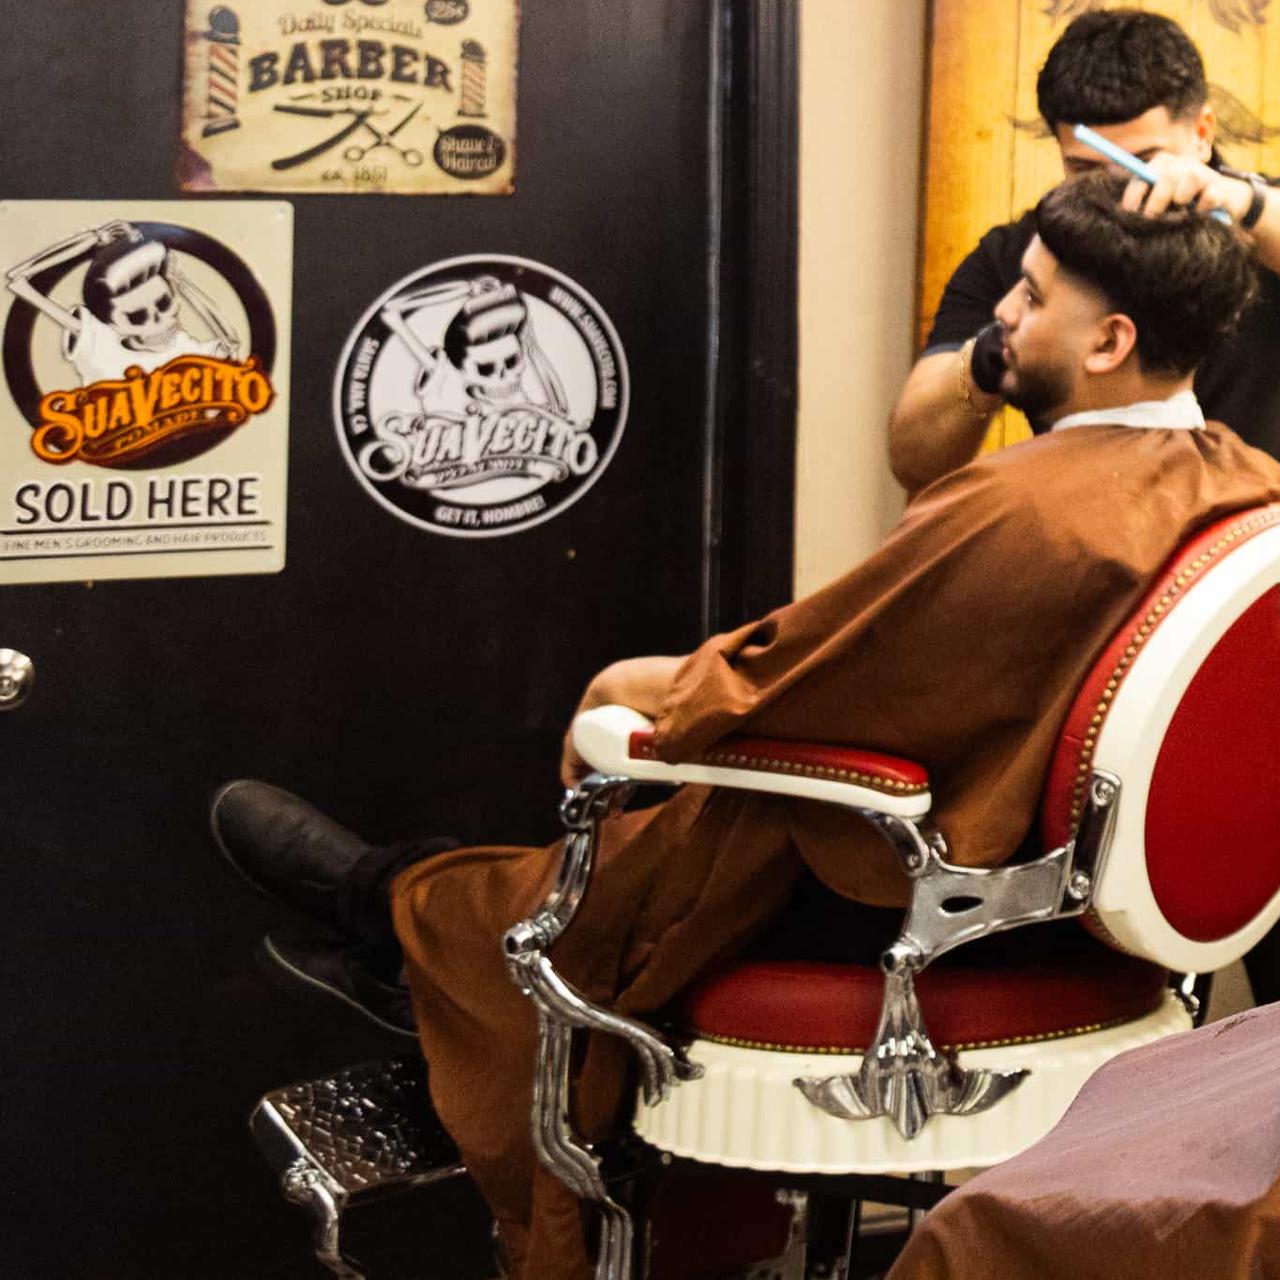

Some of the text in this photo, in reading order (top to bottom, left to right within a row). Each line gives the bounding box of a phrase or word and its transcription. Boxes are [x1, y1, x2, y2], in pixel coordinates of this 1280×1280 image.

[248, 38, 453, 94] BARBER
[322, 87, 383, 103] SHOP
[30, 355, 276, 465] SUAVECITO
[359, 404, 600, 482] SUAVECITO
[15, 477, 259, 525] SOLD HERE
